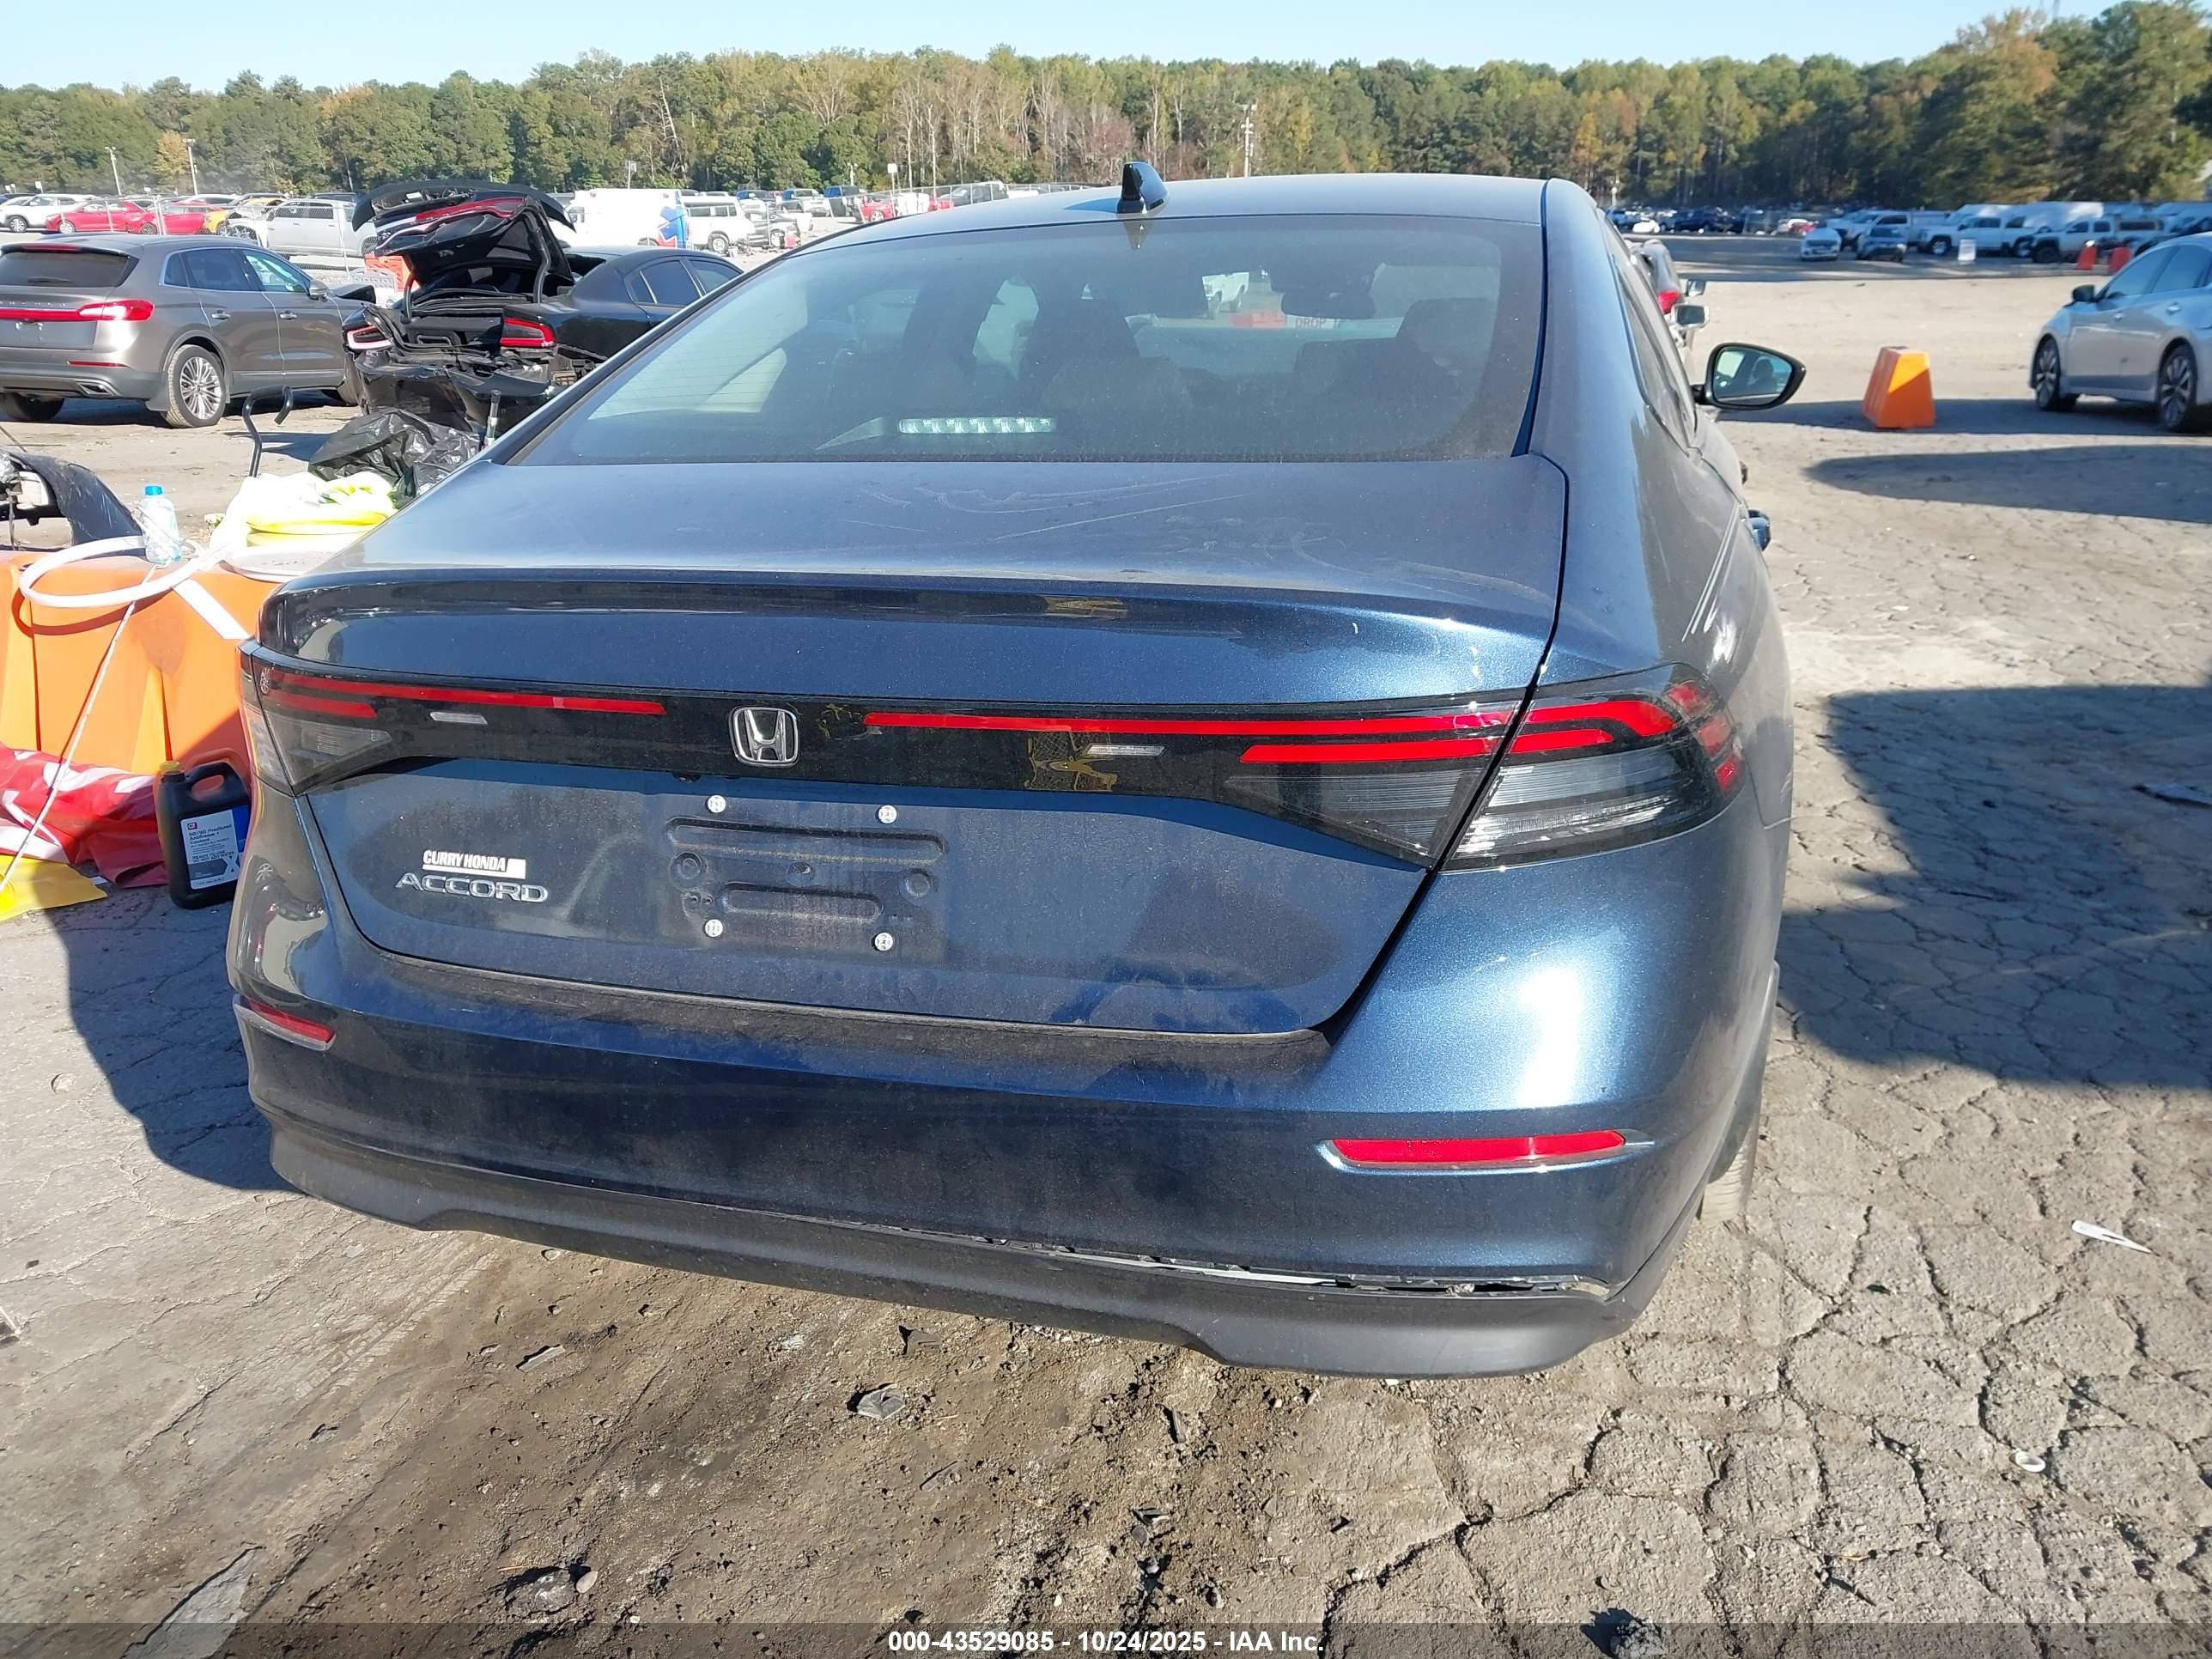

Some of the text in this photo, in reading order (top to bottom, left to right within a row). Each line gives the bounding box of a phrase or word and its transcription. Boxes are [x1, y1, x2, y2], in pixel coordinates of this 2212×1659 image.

[423, 850, 507, 872] CURRY HONDA
[395, 872, 549, 903] ACCORD
